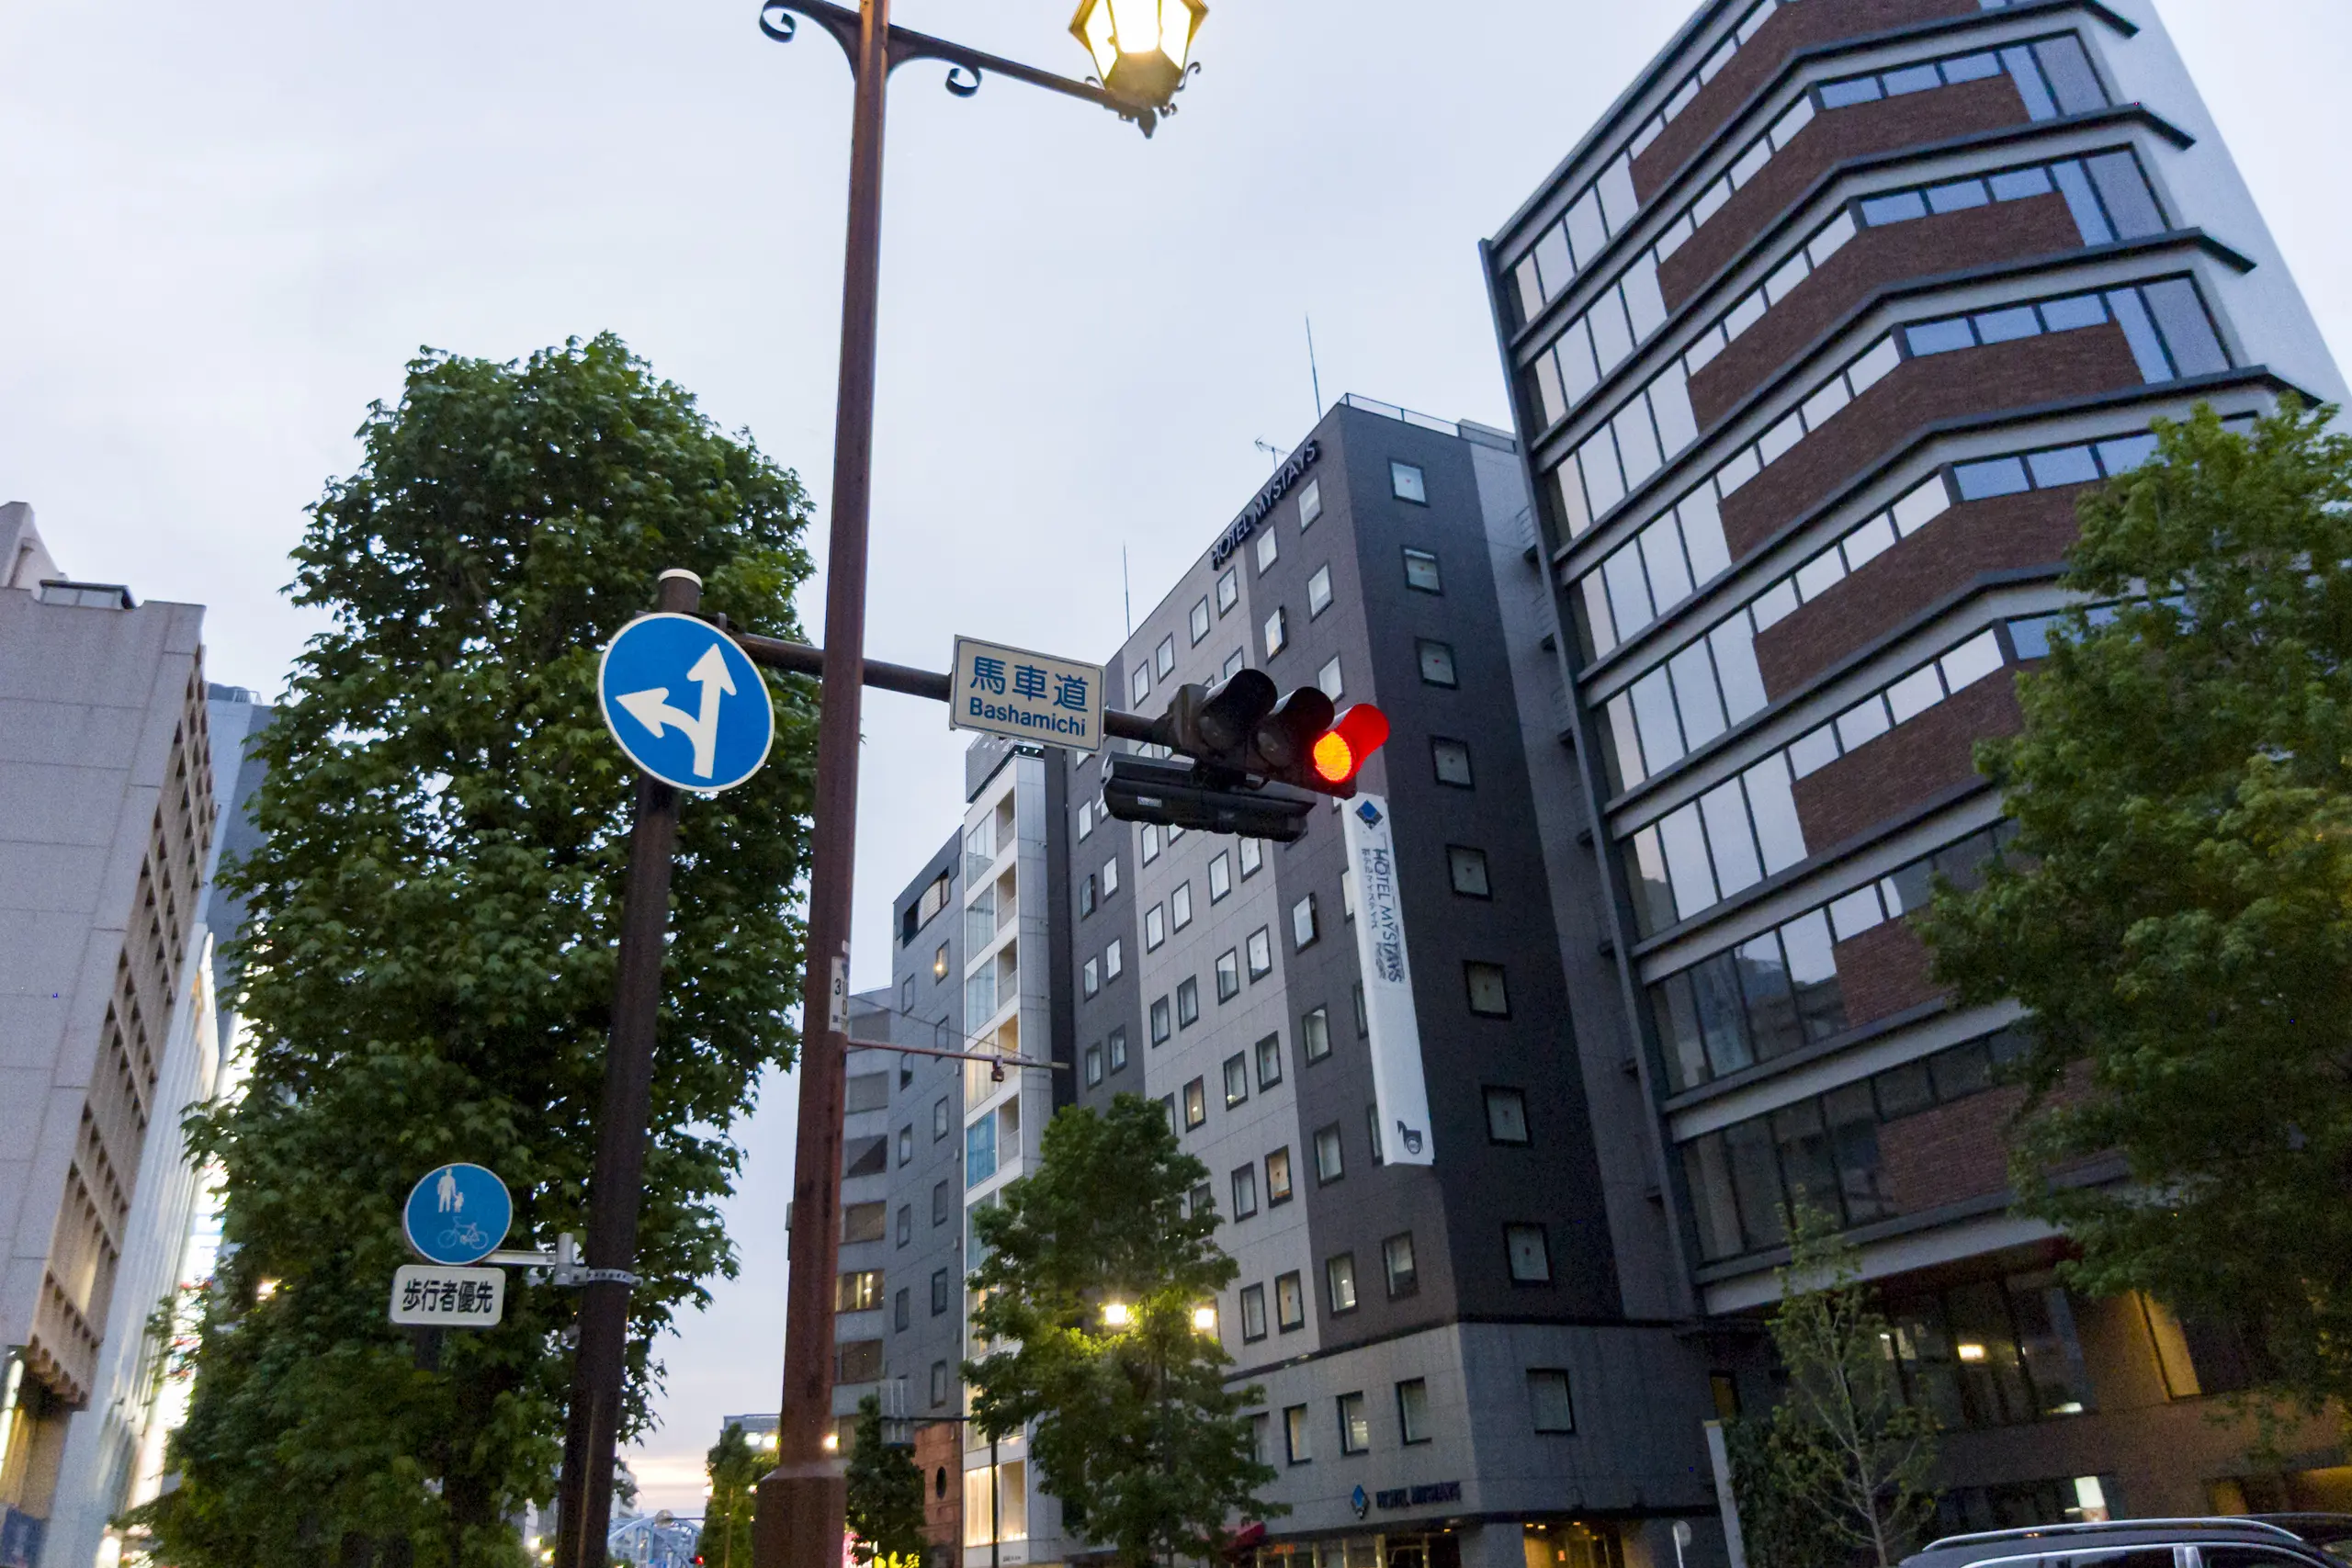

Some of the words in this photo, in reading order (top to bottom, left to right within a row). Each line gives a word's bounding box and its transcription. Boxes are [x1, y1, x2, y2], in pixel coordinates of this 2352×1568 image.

[1212, 512, 1252, 570] HOTEL
[1252, 439, 1320, 525] MYSTAYS
[970, 656, 1089, 713] 馬車道
[969, 696, 1086, 737] Bashamichi
[1373, 848, 1390, 900] HOTEL
[1379, 904, 1403, 983] MYSTAYS
[402, 1278, 493, 1314] 歩行者優先
